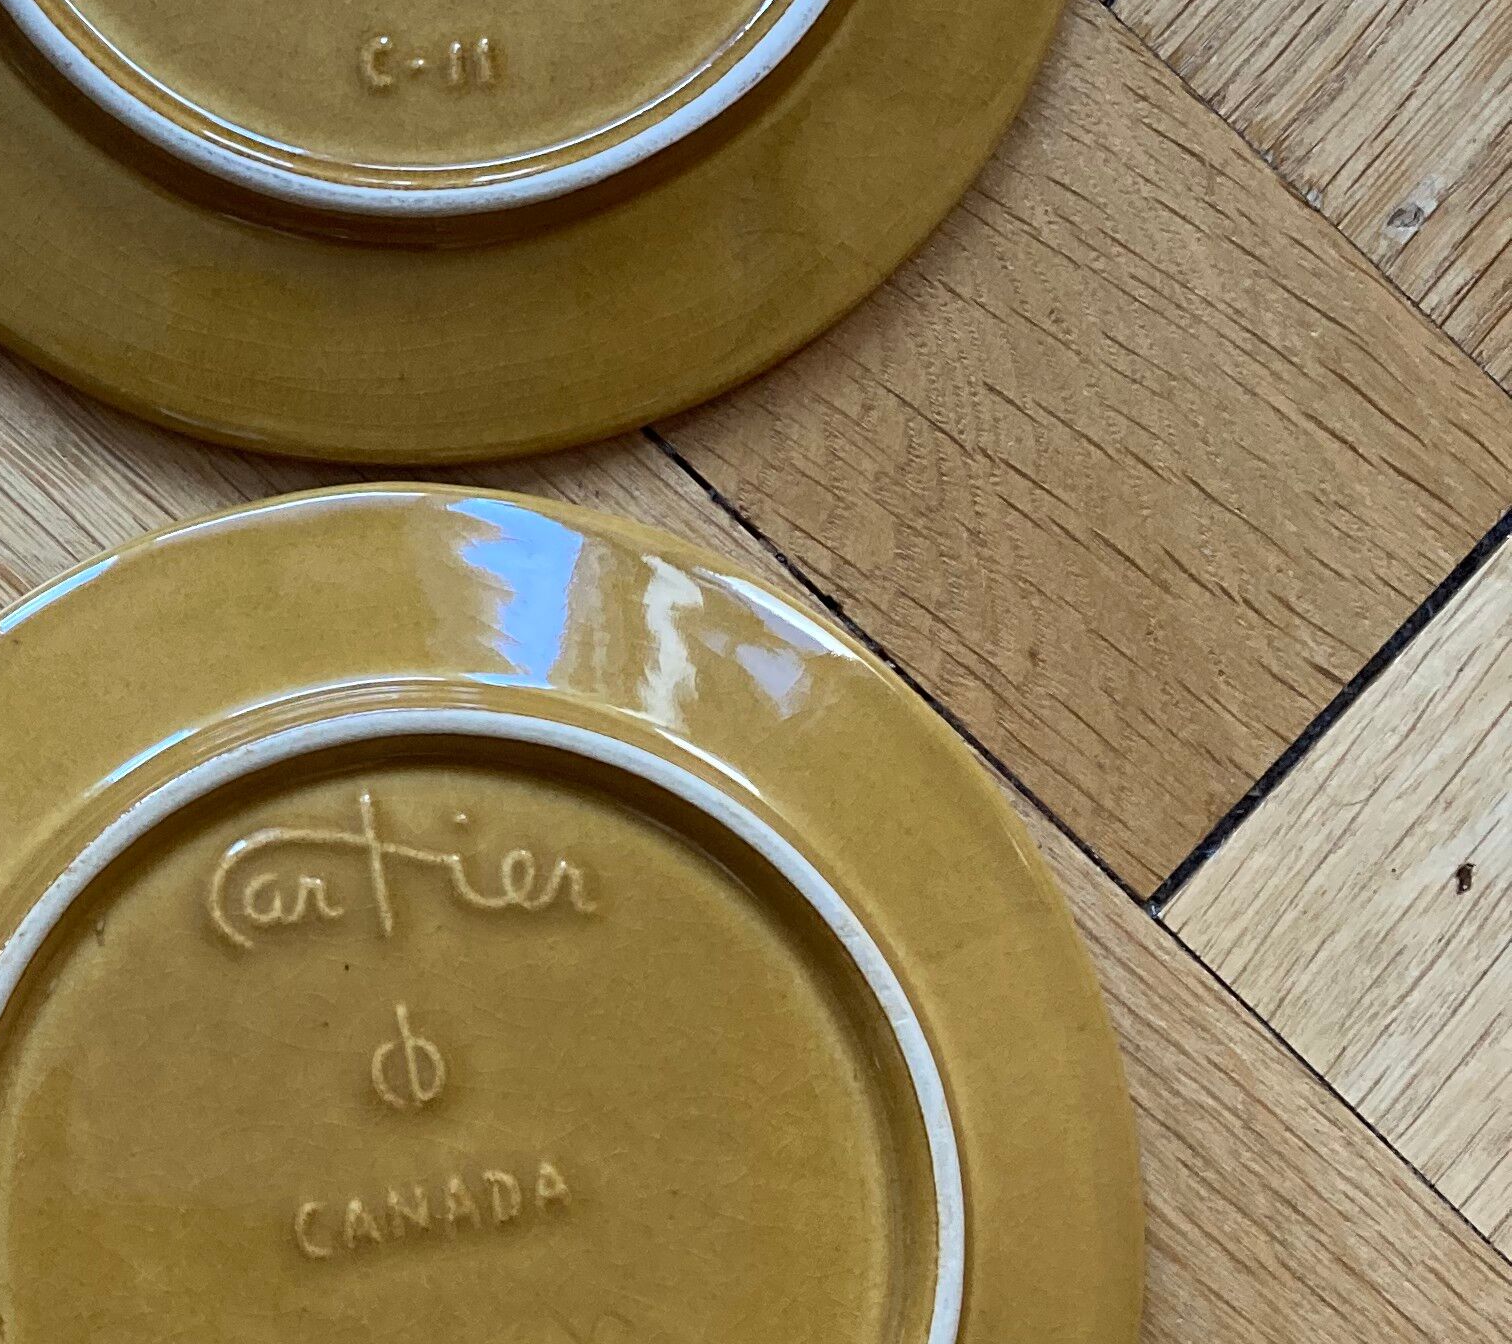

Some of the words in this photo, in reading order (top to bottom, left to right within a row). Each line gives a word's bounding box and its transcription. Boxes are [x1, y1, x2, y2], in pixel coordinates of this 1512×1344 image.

[364, 33, 498, 90] C-11
[208, 788, 598, 948] Cartier
[294, 1159, 574, 1258] CANADA
